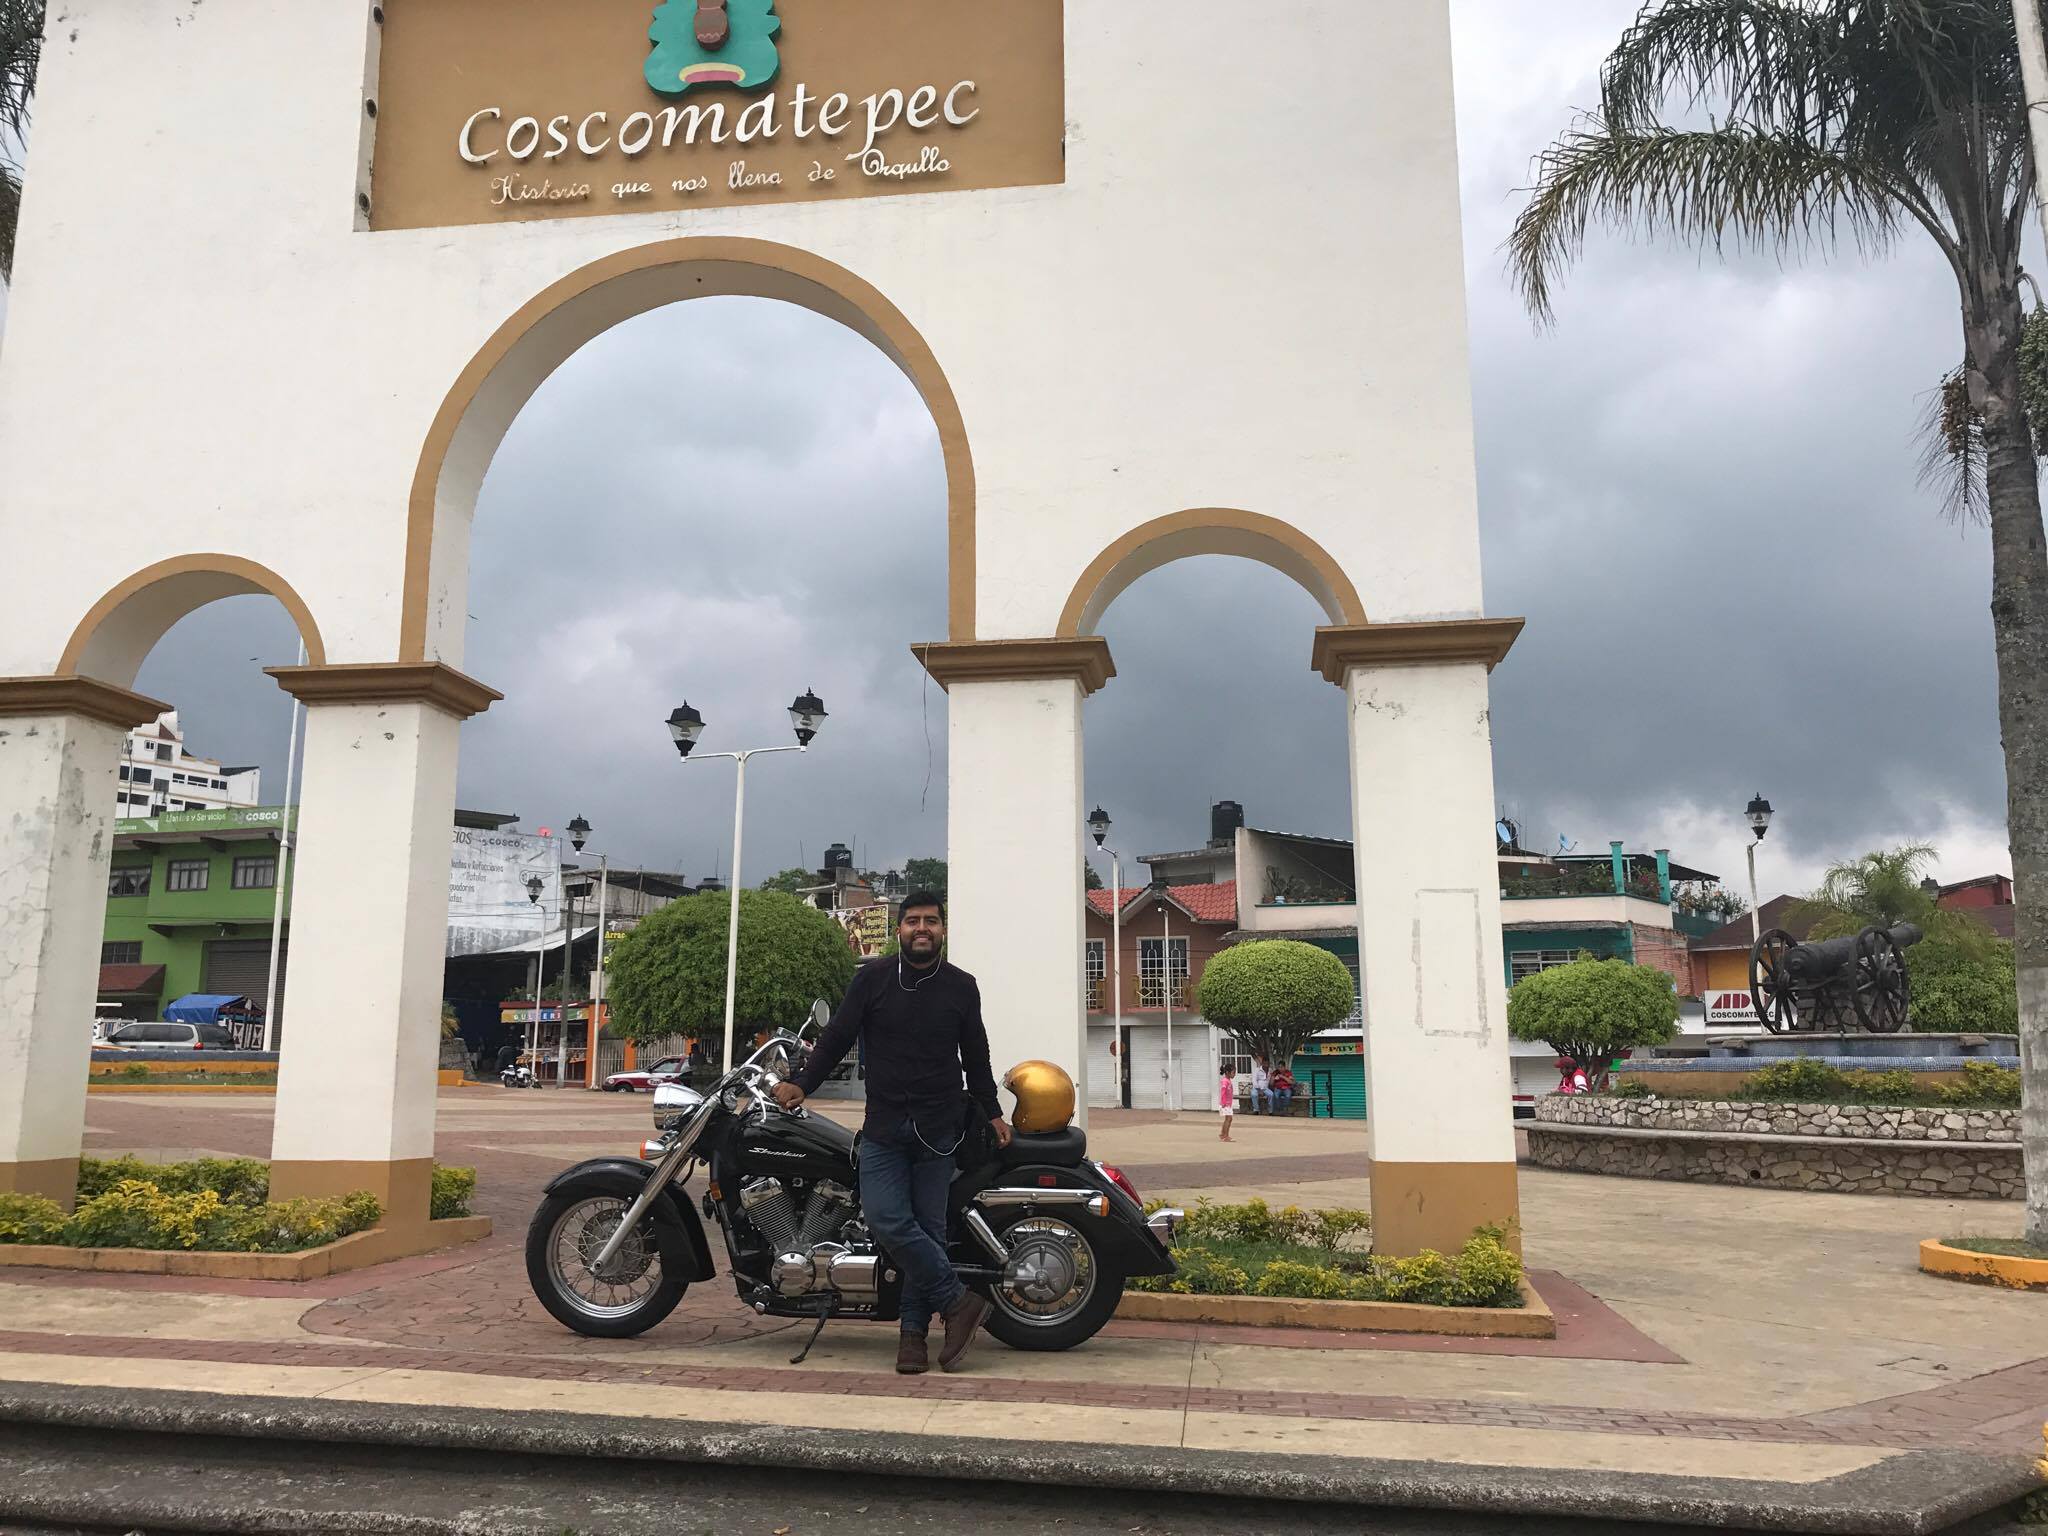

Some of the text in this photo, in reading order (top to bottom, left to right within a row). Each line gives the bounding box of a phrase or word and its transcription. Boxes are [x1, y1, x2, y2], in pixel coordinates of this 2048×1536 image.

[458, 80, 980, 163] Coscomatepec
[490, 172, 592, 205] Historia
[611, 180, 653, 198] que
[671, 175, 708, 191] nos
[728, 160, 783, 189] llena
[807, 161, 836, 181] de
[1710, 1011, 1775, 1019] COSCOMATEC
